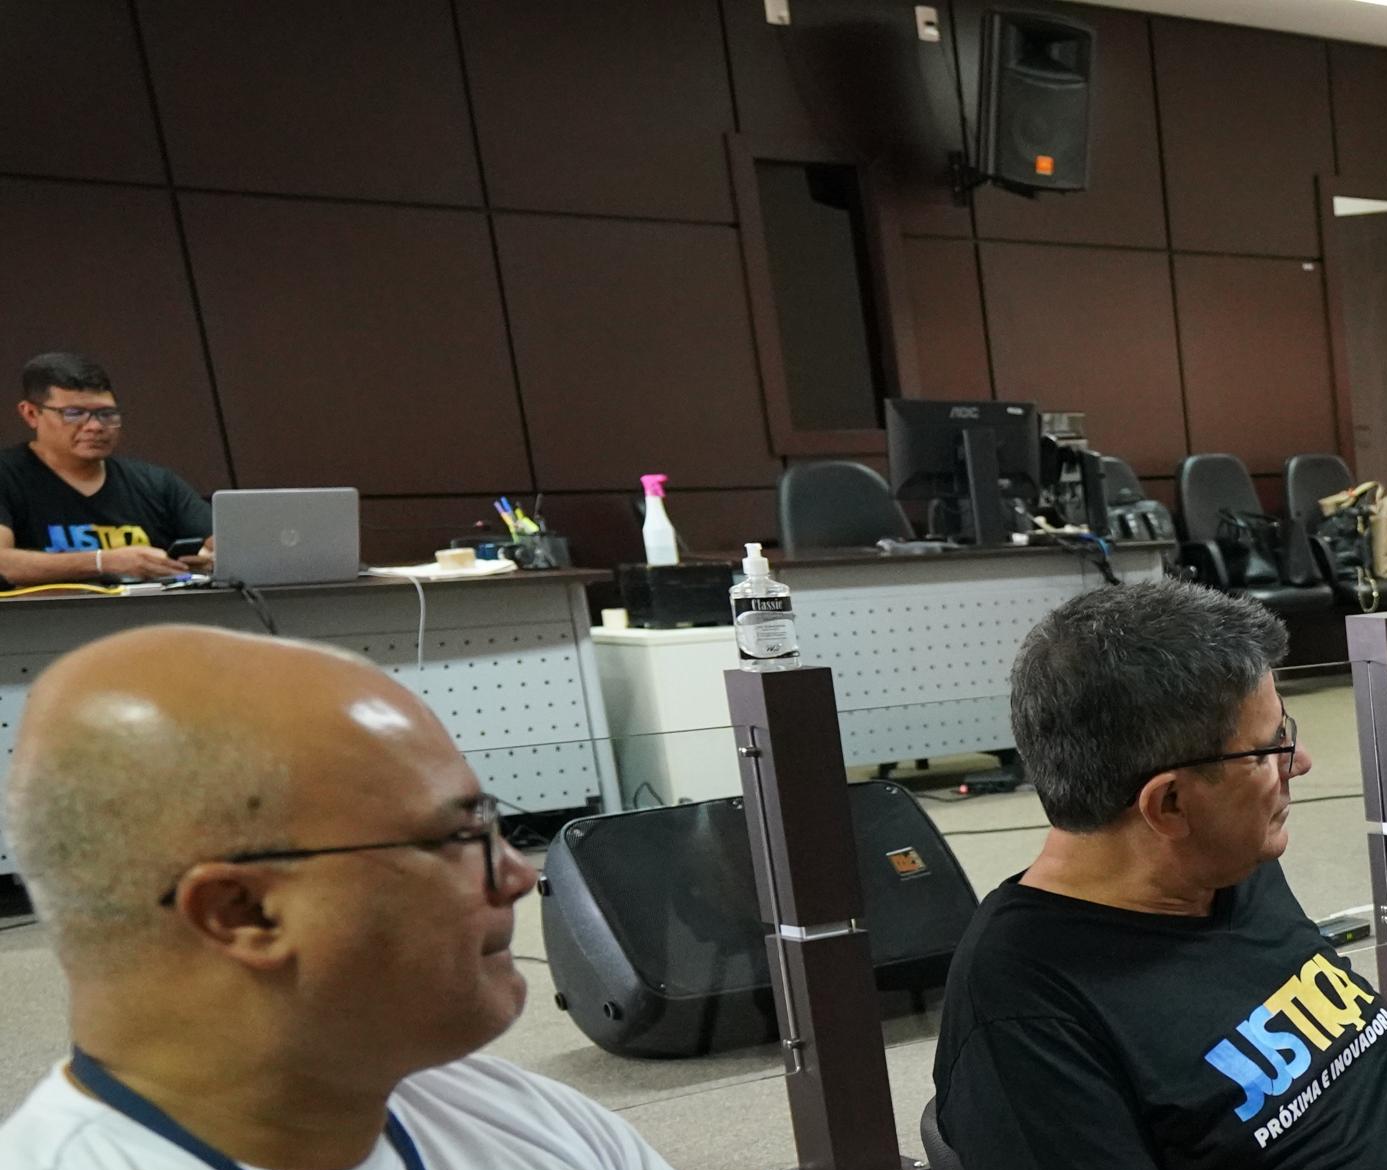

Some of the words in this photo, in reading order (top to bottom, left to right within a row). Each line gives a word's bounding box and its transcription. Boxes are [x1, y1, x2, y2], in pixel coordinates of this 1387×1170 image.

[752, 598, 783, 611] Classic
[1203, 953, 1375, 1123] JUSTIÇA
[1253, 1082, 1322, 1149] PRÓXIMA
[1321, 1072, 1332, 1089] E
